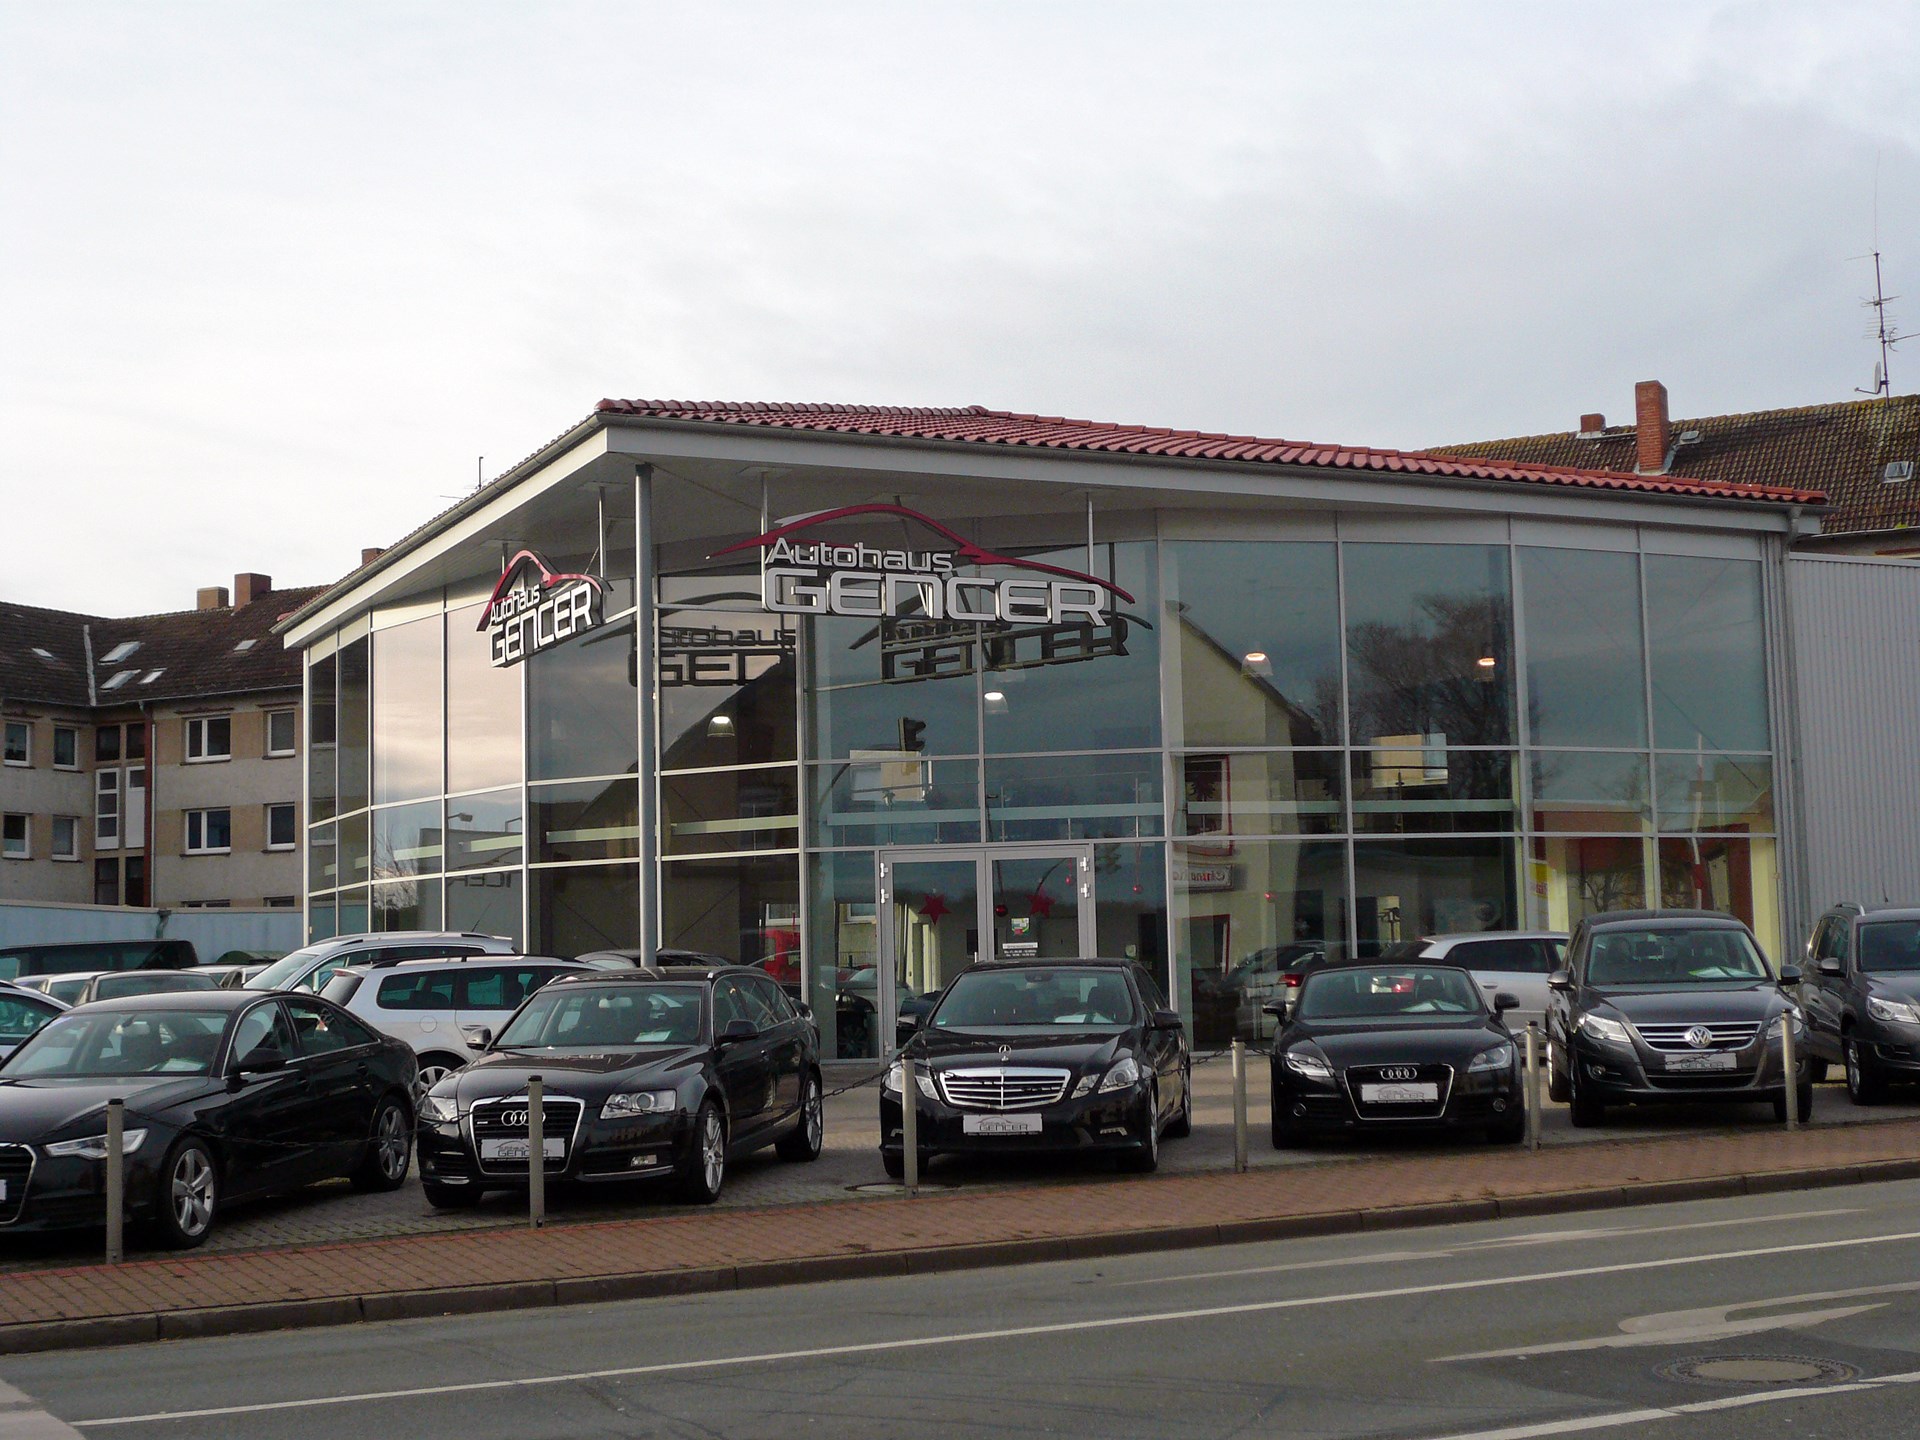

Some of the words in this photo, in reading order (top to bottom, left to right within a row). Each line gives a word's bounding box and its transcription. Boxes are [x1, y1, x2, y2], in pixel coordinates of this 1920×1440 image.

[766, 537, 953, 572] Autohaus
[491, 584, 541, 622] Autohaus
[764, 568, 1106, 626] GENCER
[491, 582, 591, 666] GENCER
